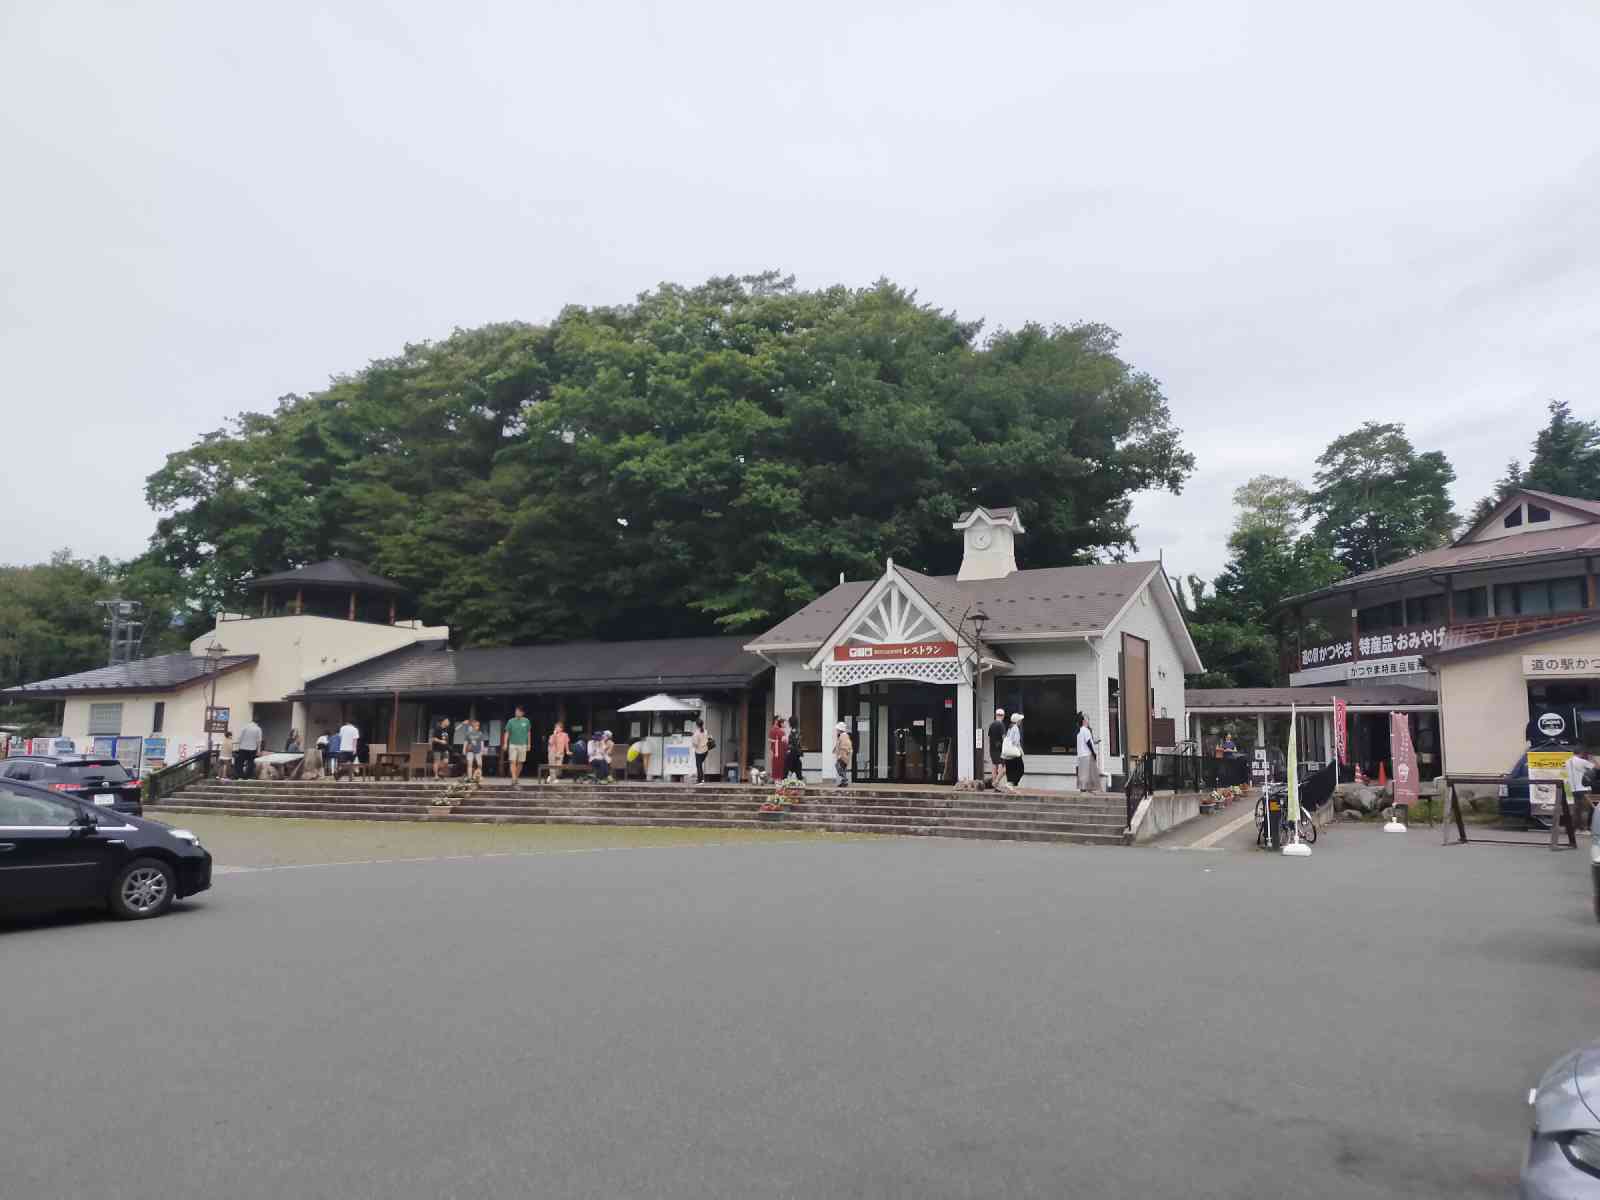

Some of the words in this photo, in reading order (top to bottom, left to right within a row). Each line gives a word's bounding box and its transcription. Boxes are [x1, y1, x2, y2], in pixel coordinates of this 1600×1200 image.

[903, 645, 942, 656] レストラン
